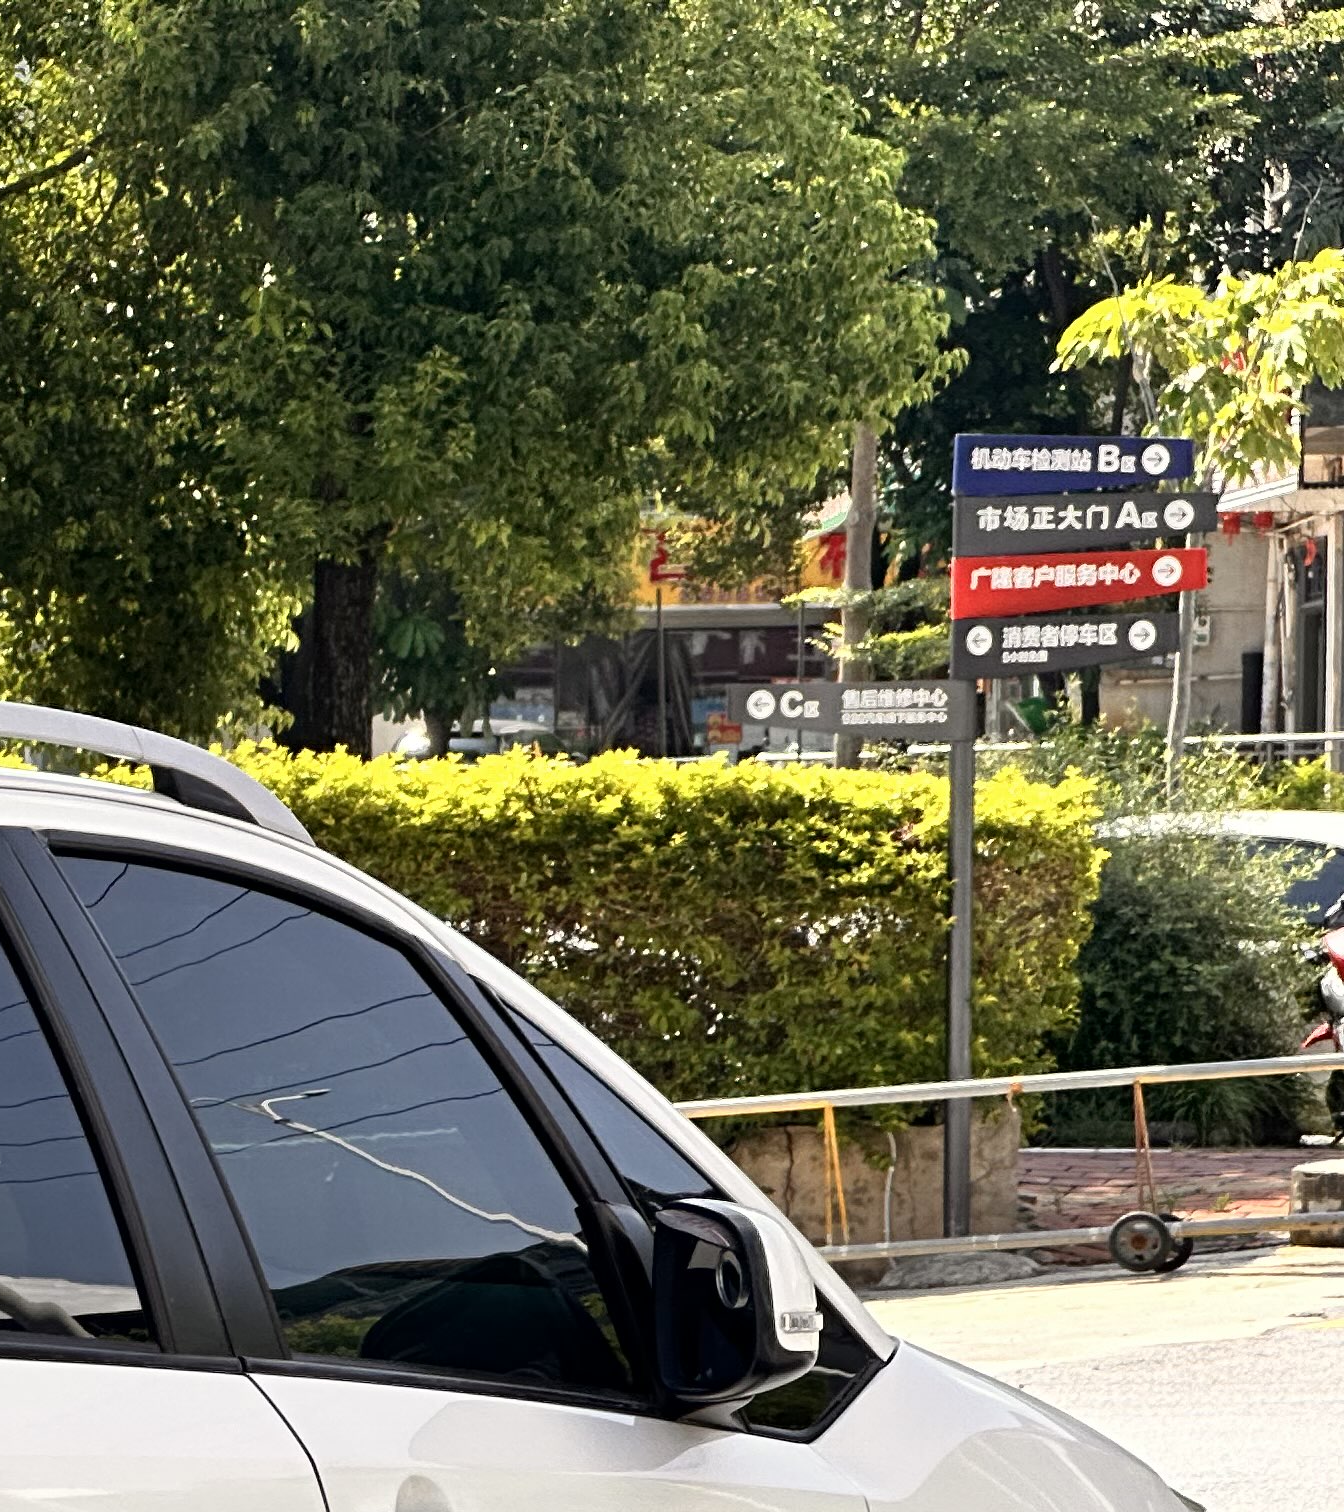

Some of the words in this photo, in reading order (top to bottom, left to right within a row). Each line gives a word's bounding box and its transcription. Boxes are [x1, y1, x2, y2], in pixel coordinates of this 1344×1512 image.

[977, 505, 1109, 531] 市场正大门
[1115, 501, 1158, 528] A区
[1002, 623, 1117, 648] 消费者停车区
